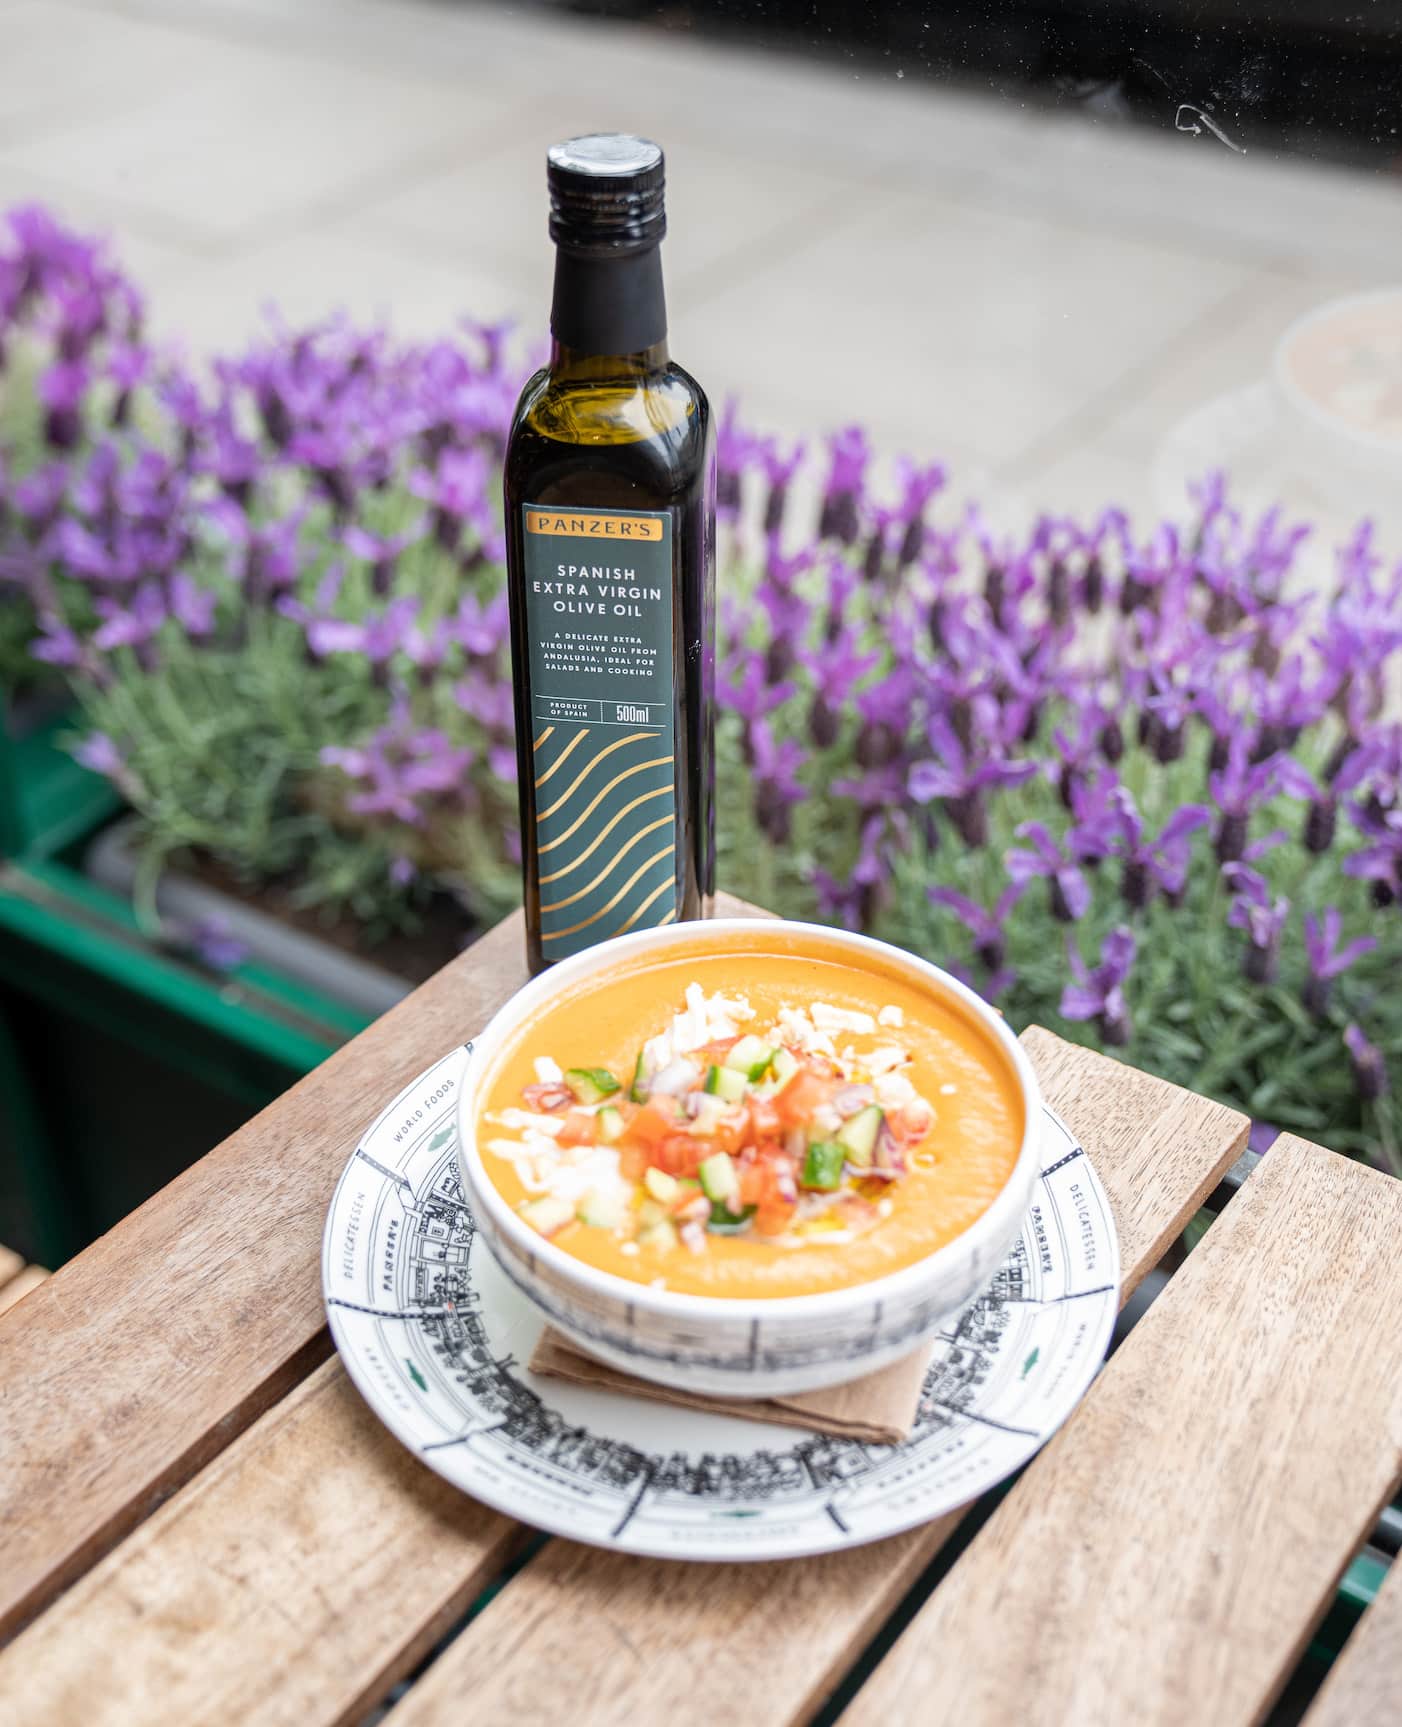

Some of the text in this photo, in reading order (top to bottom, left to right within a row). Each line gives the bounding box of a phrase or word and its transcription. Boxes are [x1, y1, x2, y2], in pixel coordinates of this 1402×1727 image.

[538, 518, 650, 536] PANZER'S
[557, 565, 635, 581] SPANISH
[533, 581, 661, 600] EXTRA VIRGIN
[553, 600, 642, 617] OLIVE OIL
[565, 633, 609, 642] DELICATE
[613, 636, 642, 644] EXTRA
[540, 642, 574, 650] VIRGIN
[578, 644, 606, 652] OLIVE
[611, 646, 627, 654] OIL
[604, 657, 631, 665] IDEAL
[545, 664, 580, 672] SALADS
[608, 667, 653, 676] COOKING
[550, 702, 587, 710] PRODUCT
[616, 705, 649, 723] 500ml
[393, 1079, 455, 1143] WORLD FOODS
[343, 1192, 366, 1280] DELICATESSEN
